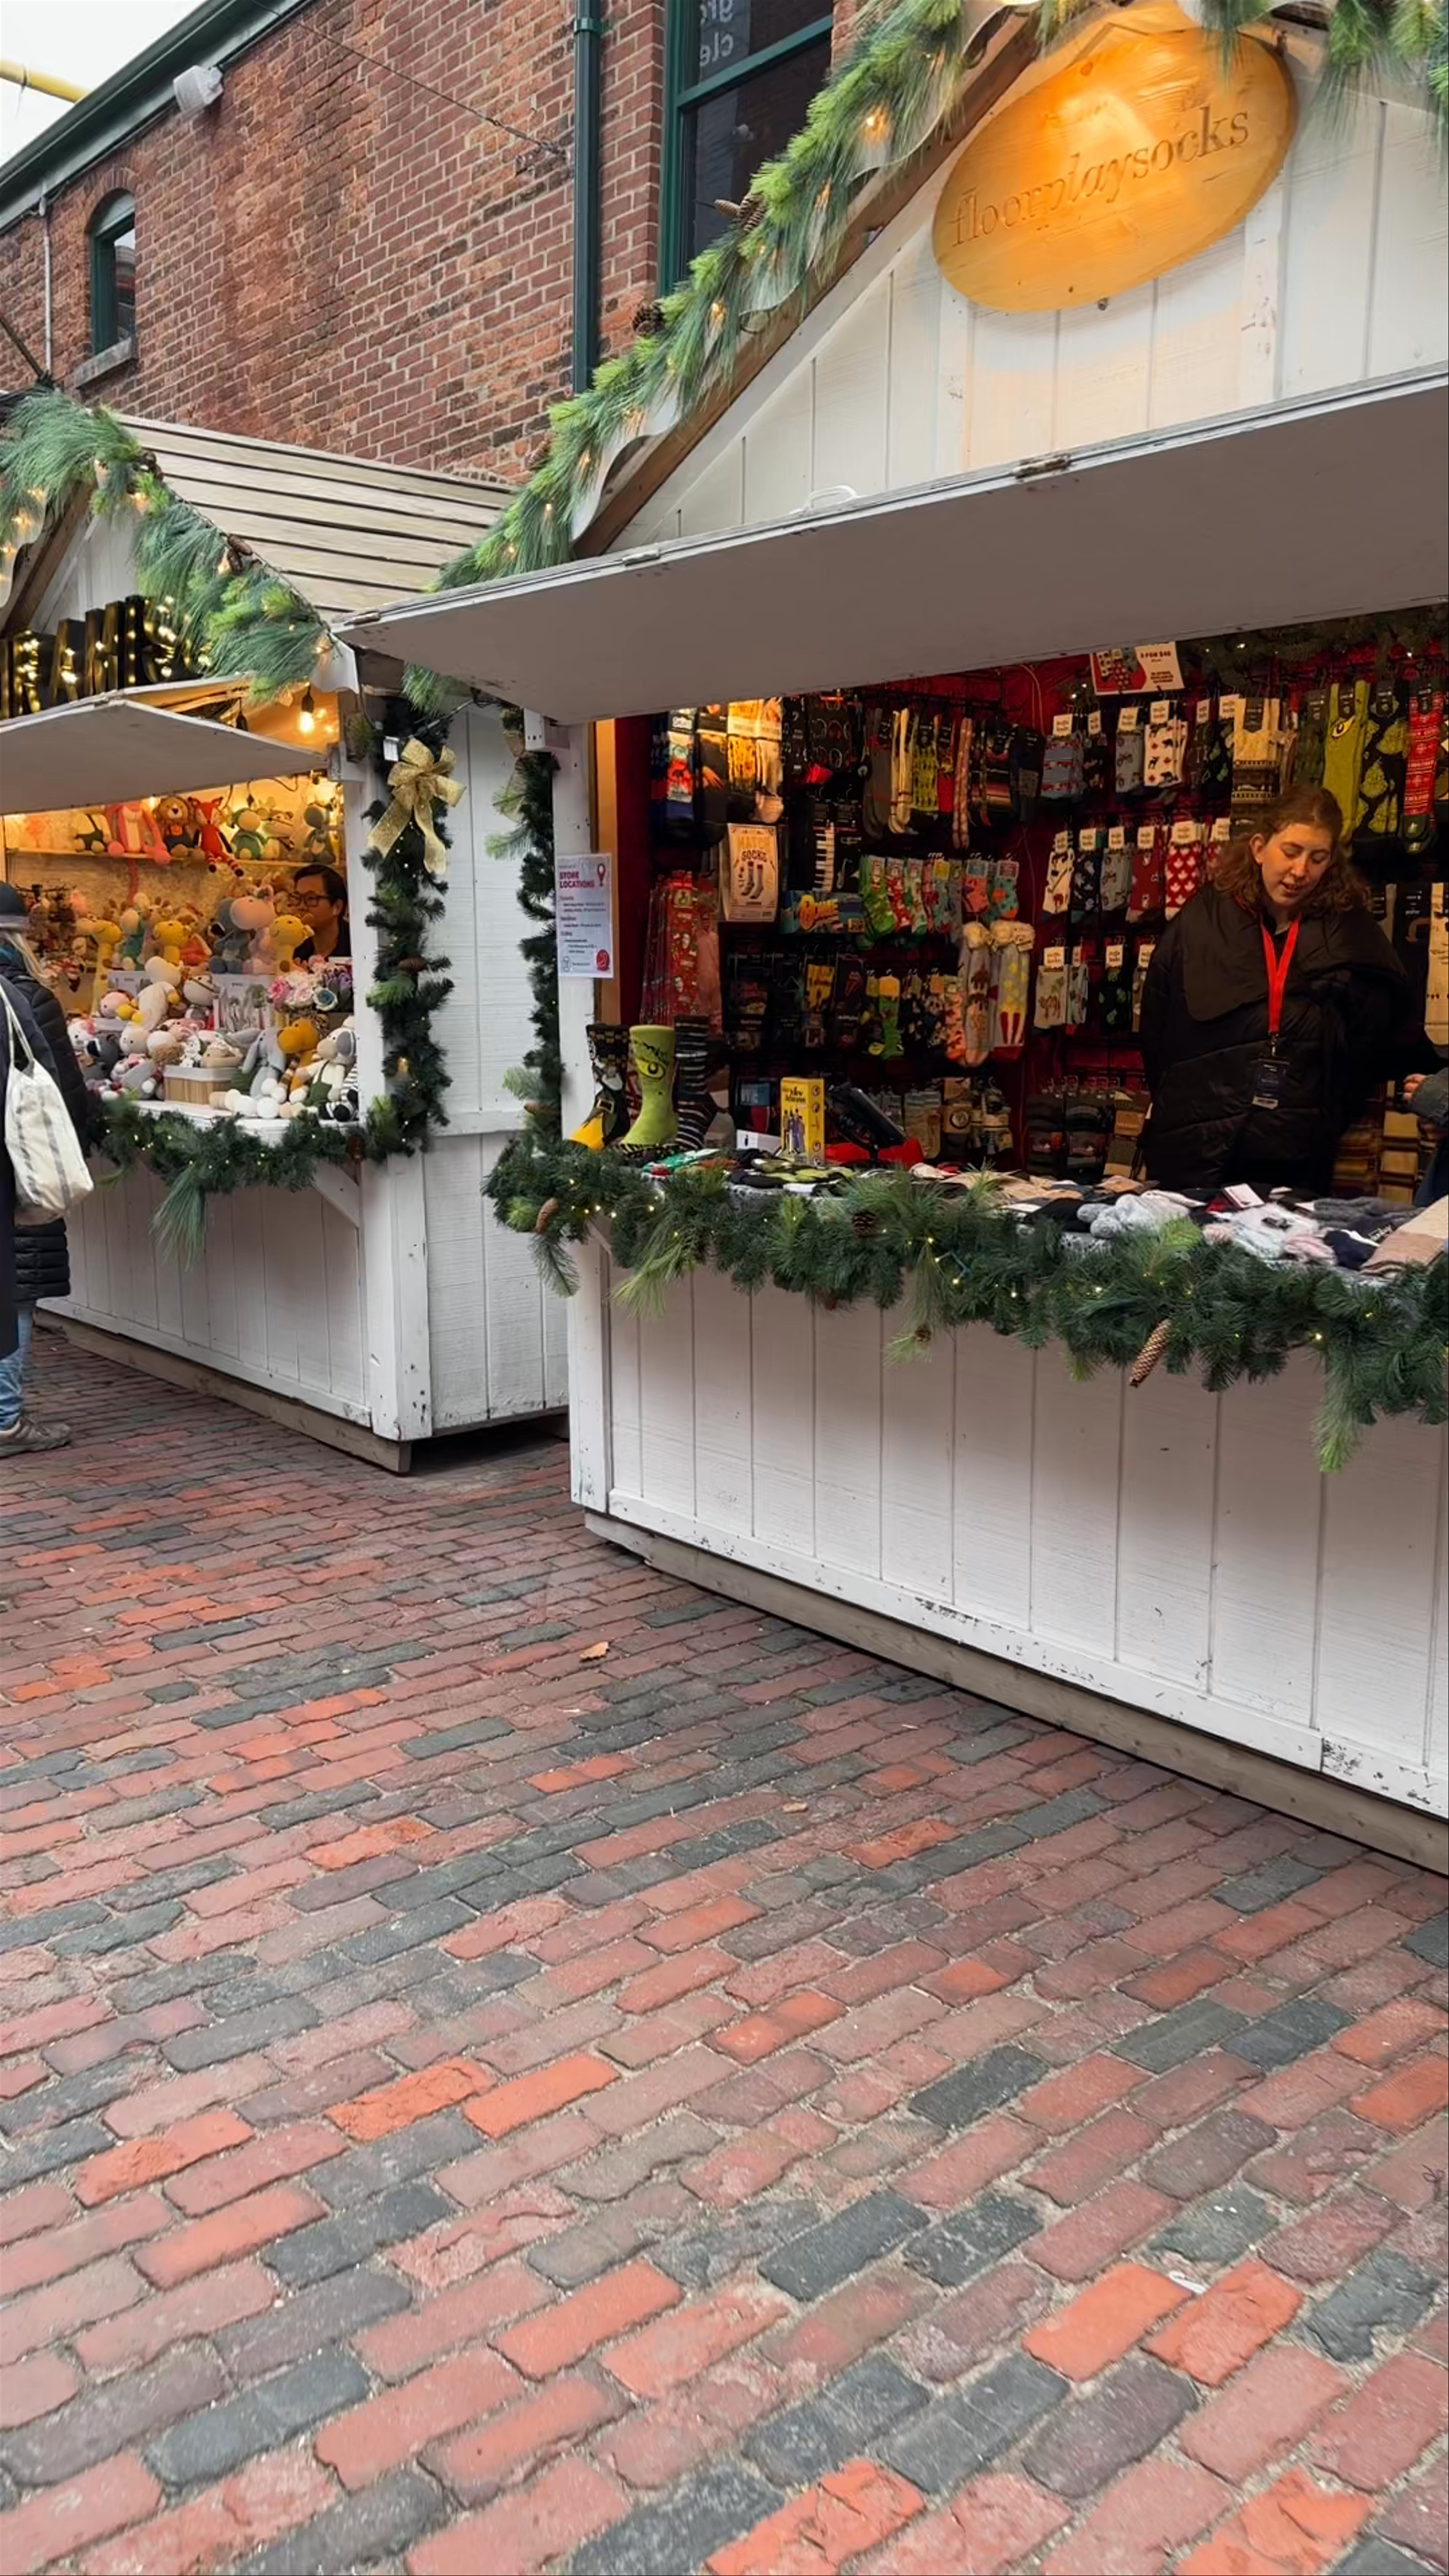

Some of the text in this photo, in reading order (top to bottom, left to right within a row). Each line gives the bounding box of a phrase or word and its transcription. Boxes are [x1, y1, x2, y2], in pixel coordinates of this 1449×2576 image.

[949, 106, 1250, 248] floorplaysocks
[741, 849, 768, 863] SOCKS
[560, 871, 579, 880] STORE
[560, 880, 595, 888] LOCATIONS
